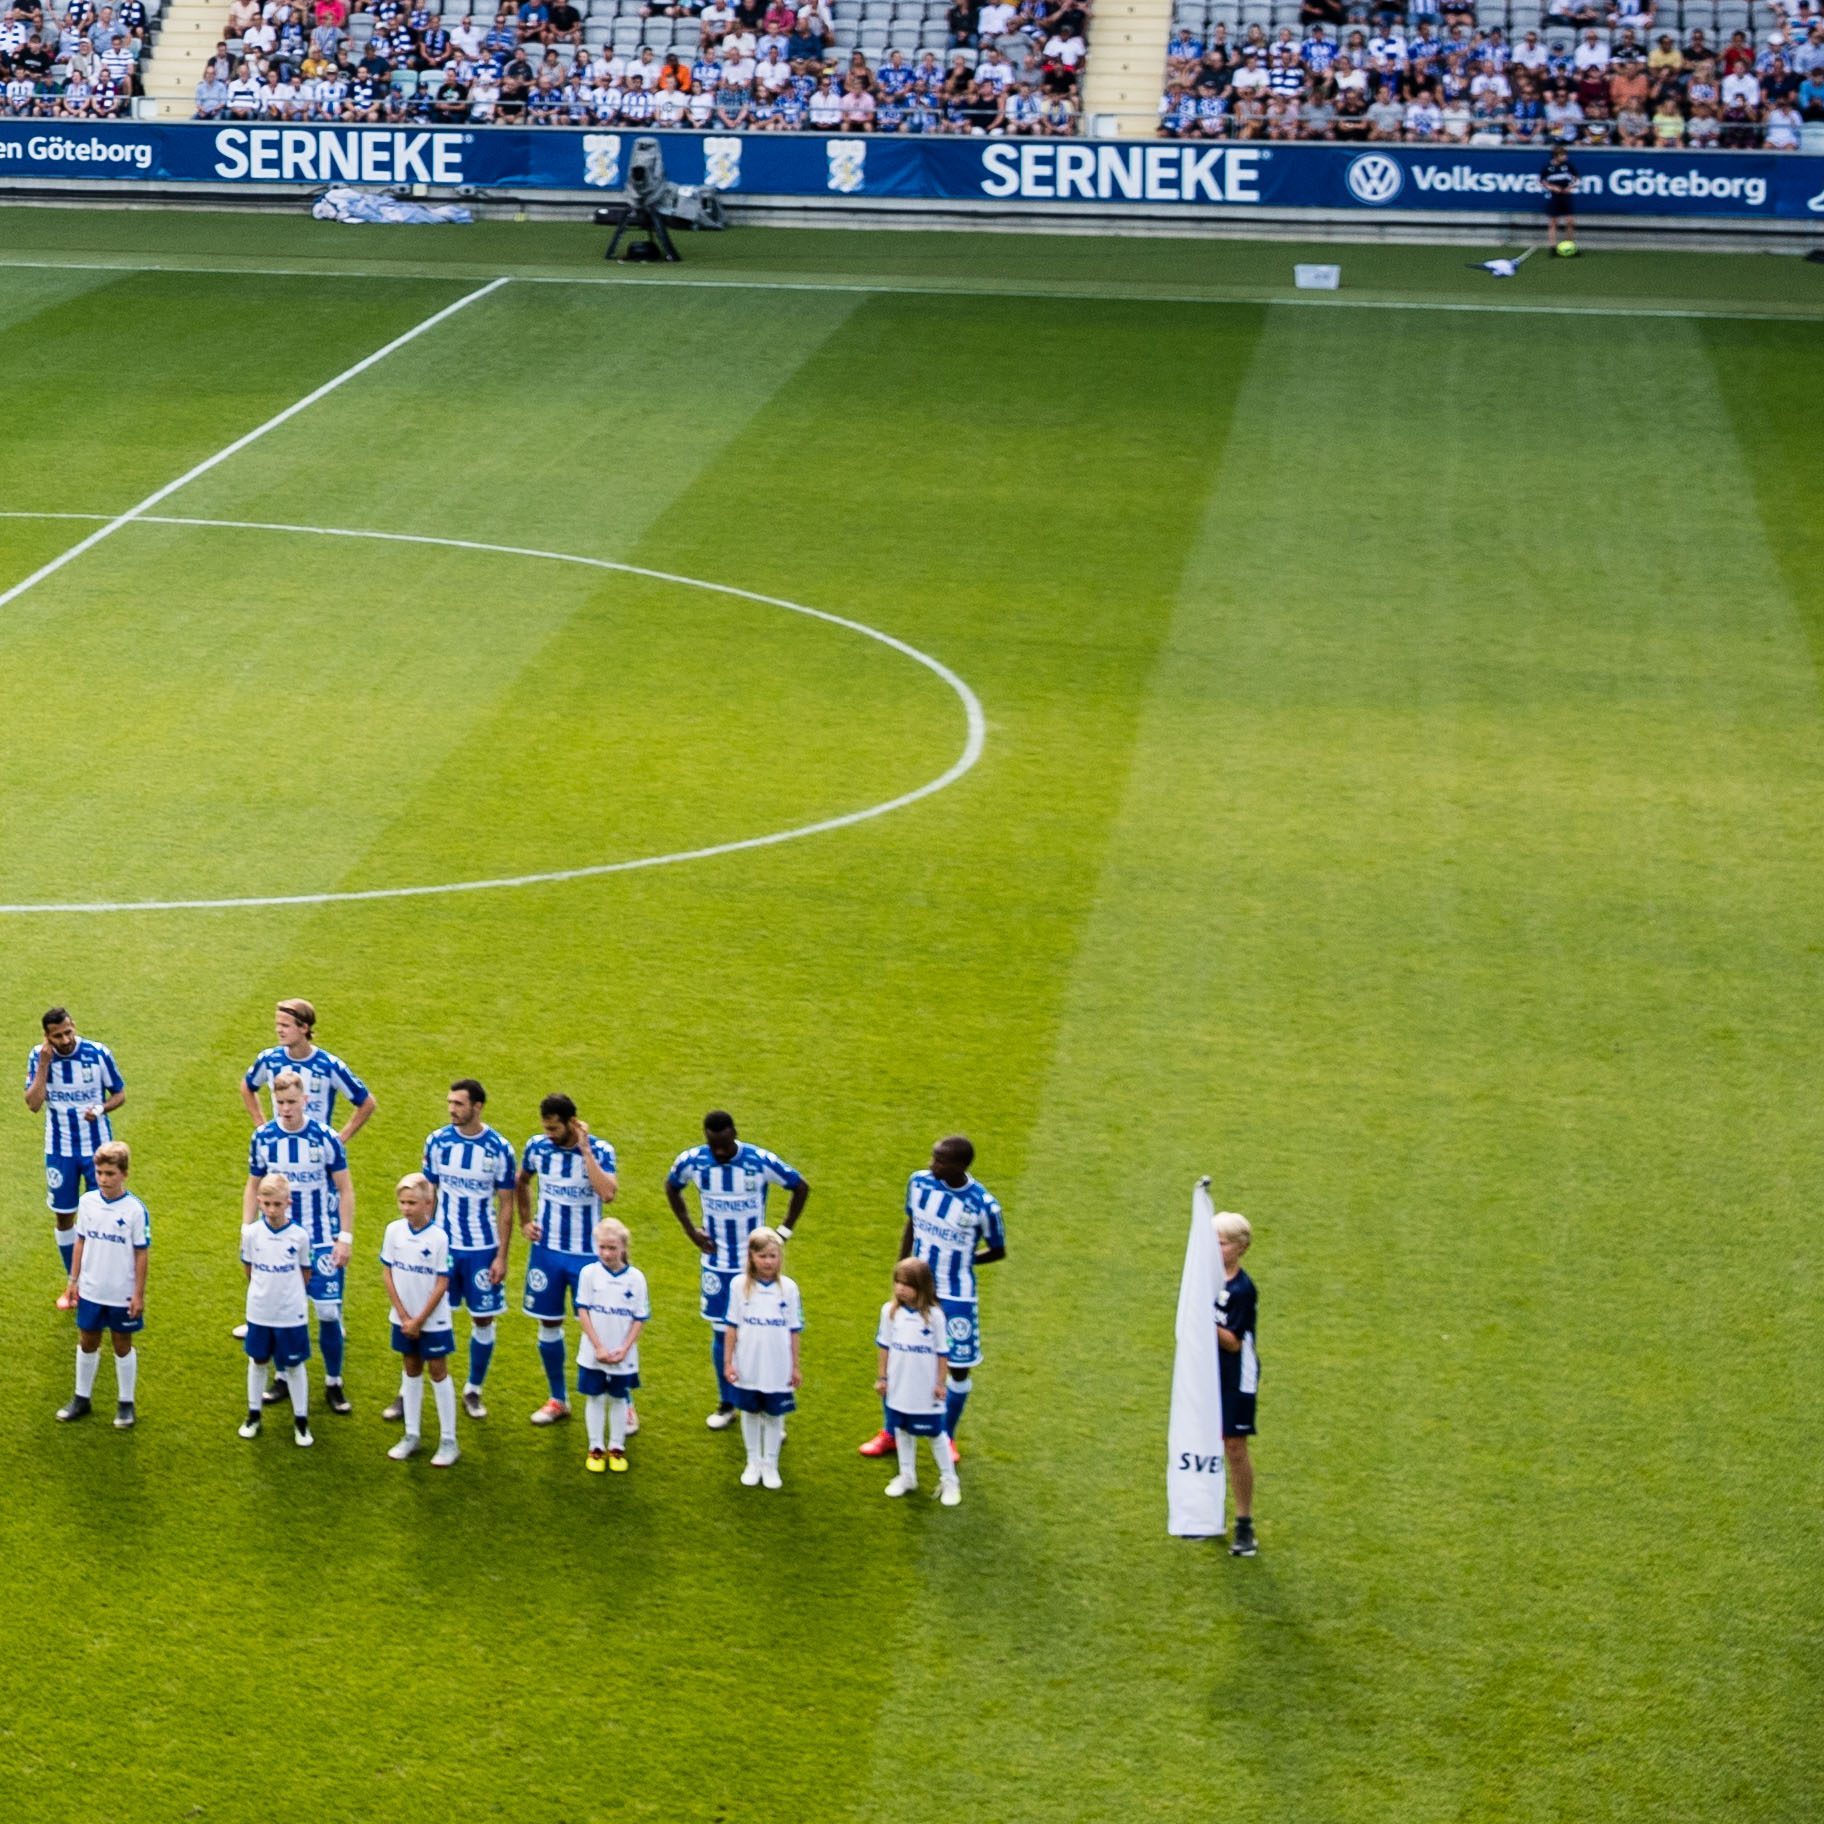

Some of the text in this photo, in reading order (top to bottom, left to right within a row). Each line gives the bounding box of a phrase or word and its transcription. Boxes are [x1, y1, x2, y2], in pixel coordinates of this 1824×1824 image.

[29, 137, 152, 169] Göteborg
[215, 129, 463, 182] SERNEKE
[981, 144, 1260, 201] SERNEKE
[1412, 165, 1767, 206] Volkswan Göteborg
[46, 1088, 97, 1101] SERNEKE
[86, 1230, 125, 1245] HOLMEN
[1178, 1453, 1221, 1474] SVE
